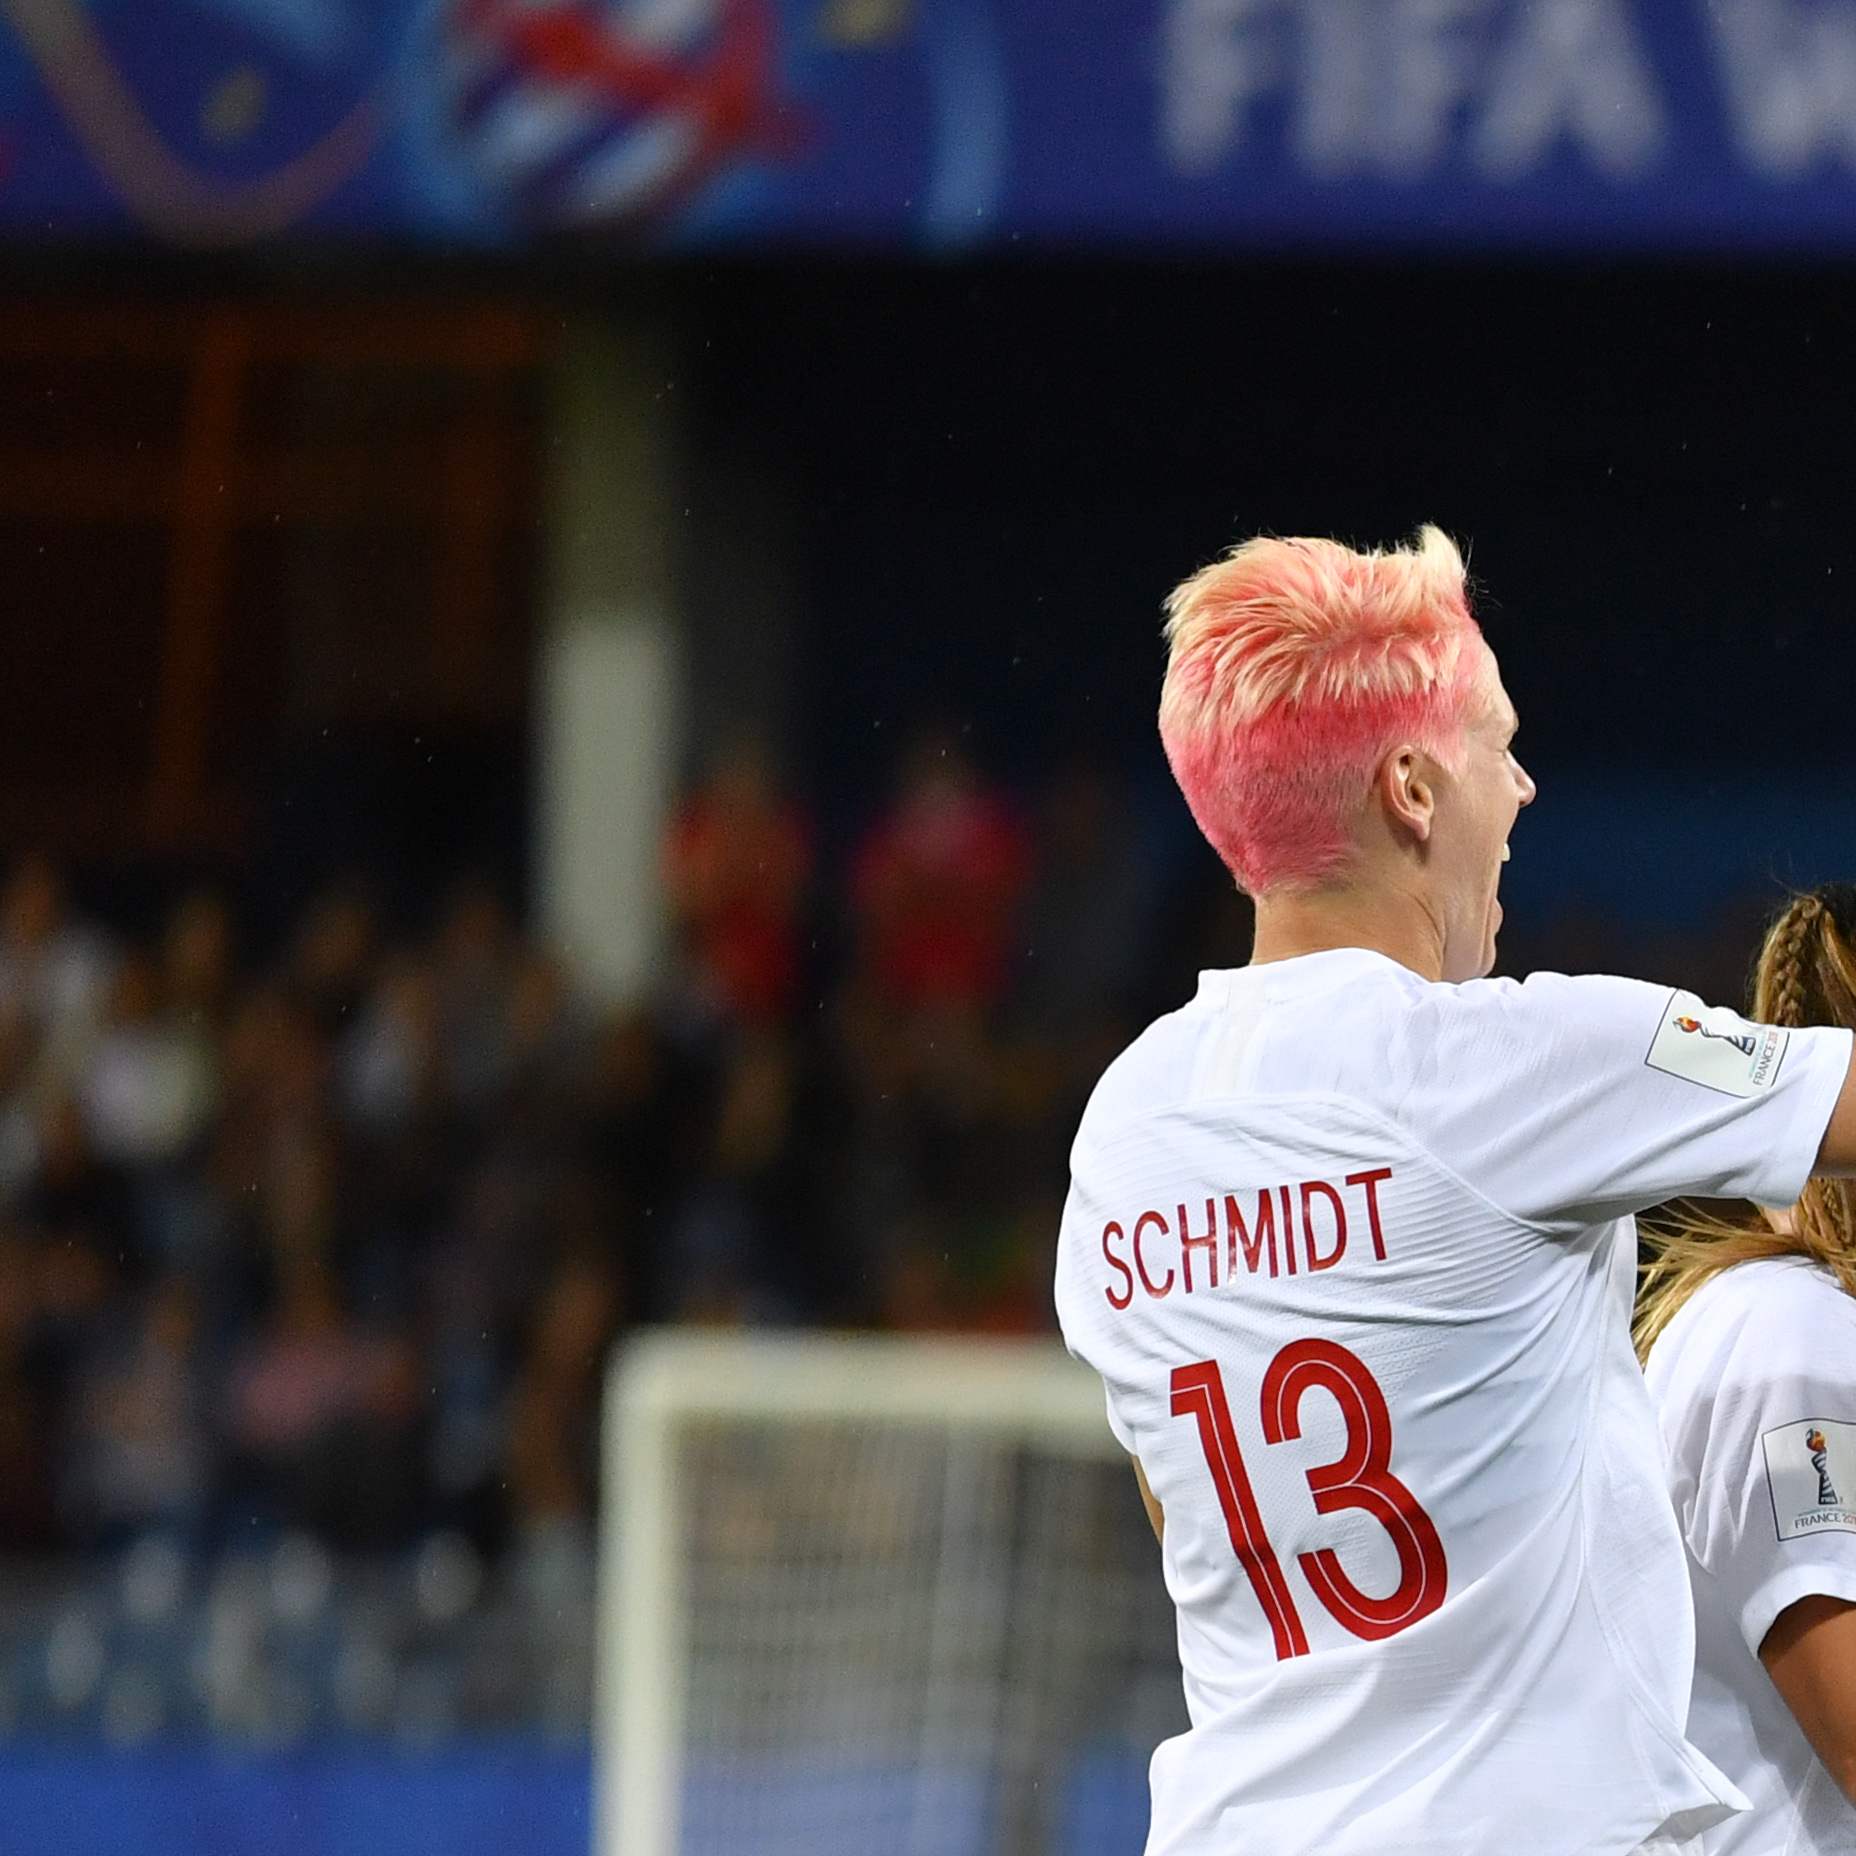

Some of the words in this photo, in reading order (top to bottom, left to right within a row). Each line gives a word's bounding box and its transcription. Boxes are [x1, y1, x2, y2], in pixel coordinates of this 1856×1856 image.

[1163, 0, 1670, 180] FIFA
[1101, 1168, 1393, 1310] SCHMIDT
[1170, 1338, 1448, 1661] 13
[1794, 1512, 1841, 1529] FRANCE
